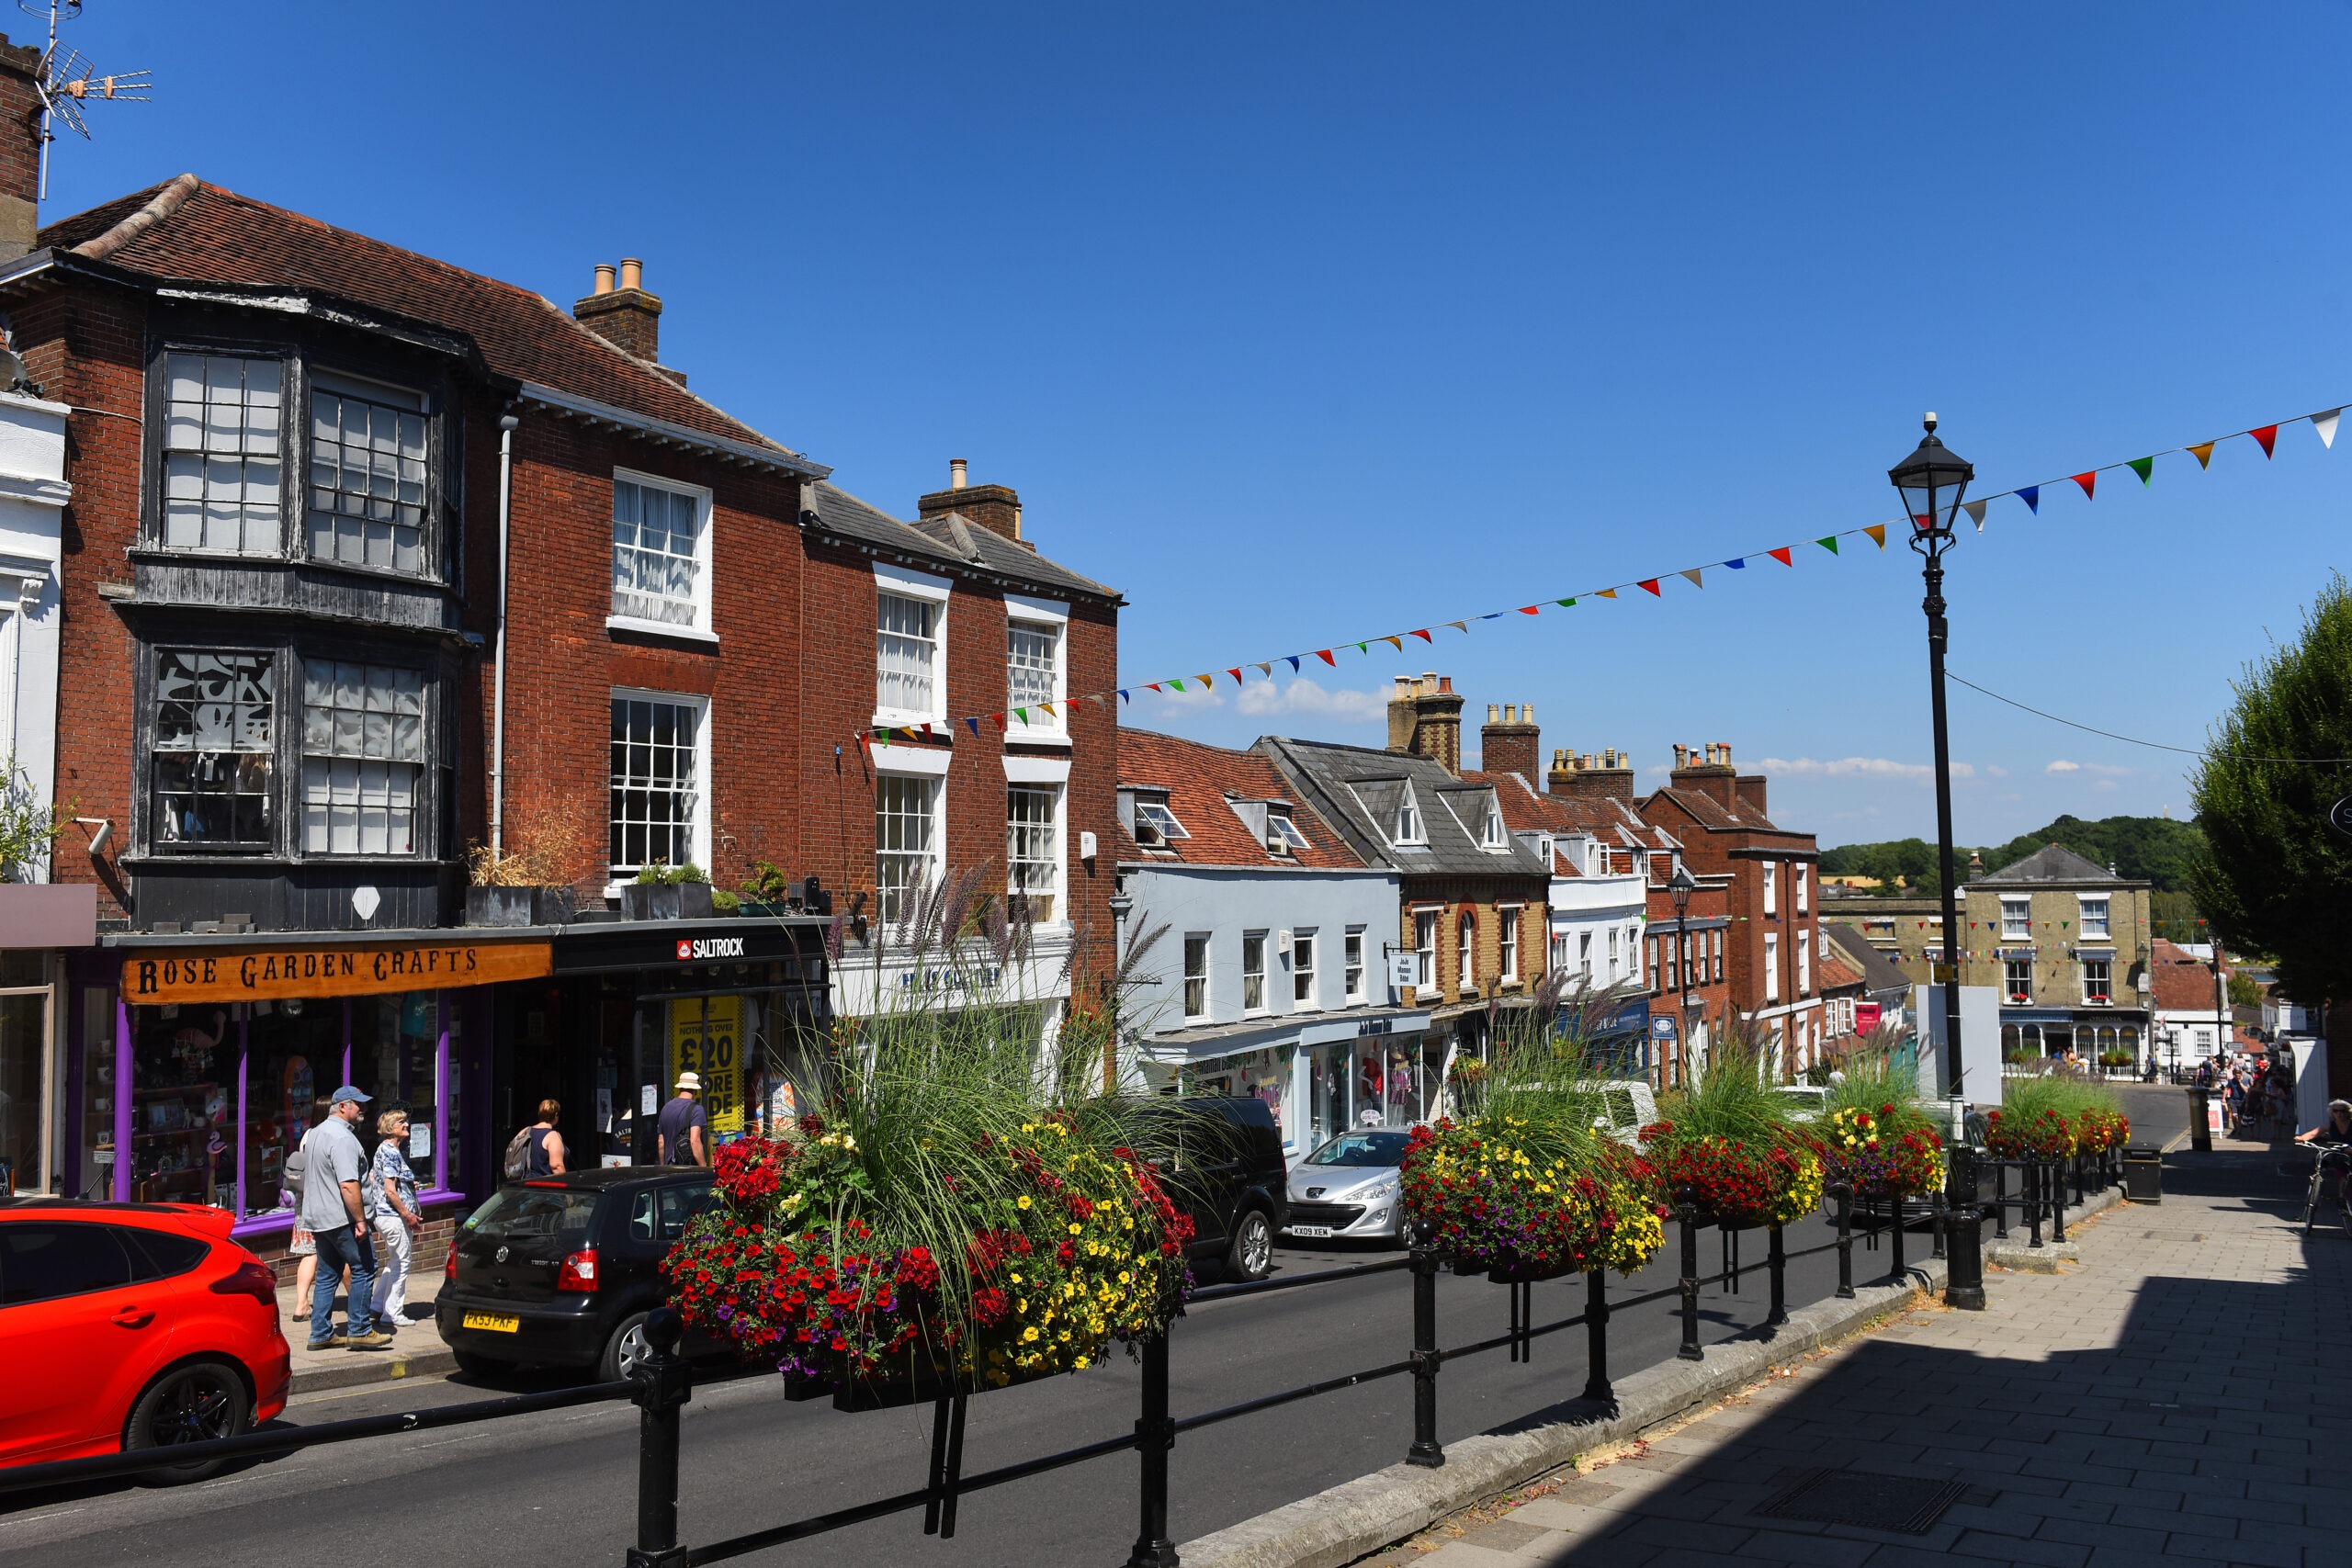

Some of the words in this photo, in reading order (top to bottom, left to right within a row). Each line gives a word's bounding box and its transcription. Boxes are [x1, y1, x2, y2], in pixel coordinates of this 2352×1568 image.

[693, 938, 743, 958] SALTROCK
[138, 958, 218, 995] ROSE
[240, 952, 355, 989] GARDEN
[373, 948, 477, 981] CRAFTS
[1396, 965, 1411, 974] Maman
[680, 1024, 714, 1035] NOTHG
[715, 1020, 733, 1033] OVER
[681, 1035, 732, 1069] £20
[615, 1127, 632, 1139] SALTR
[1294, 1226, 1312, 1235] KX09
[1313, 1227, 1329, 1236] XEM
[466, 1312, 492, 1326] PK53
[492, 1313, 514, 1329] PKF
